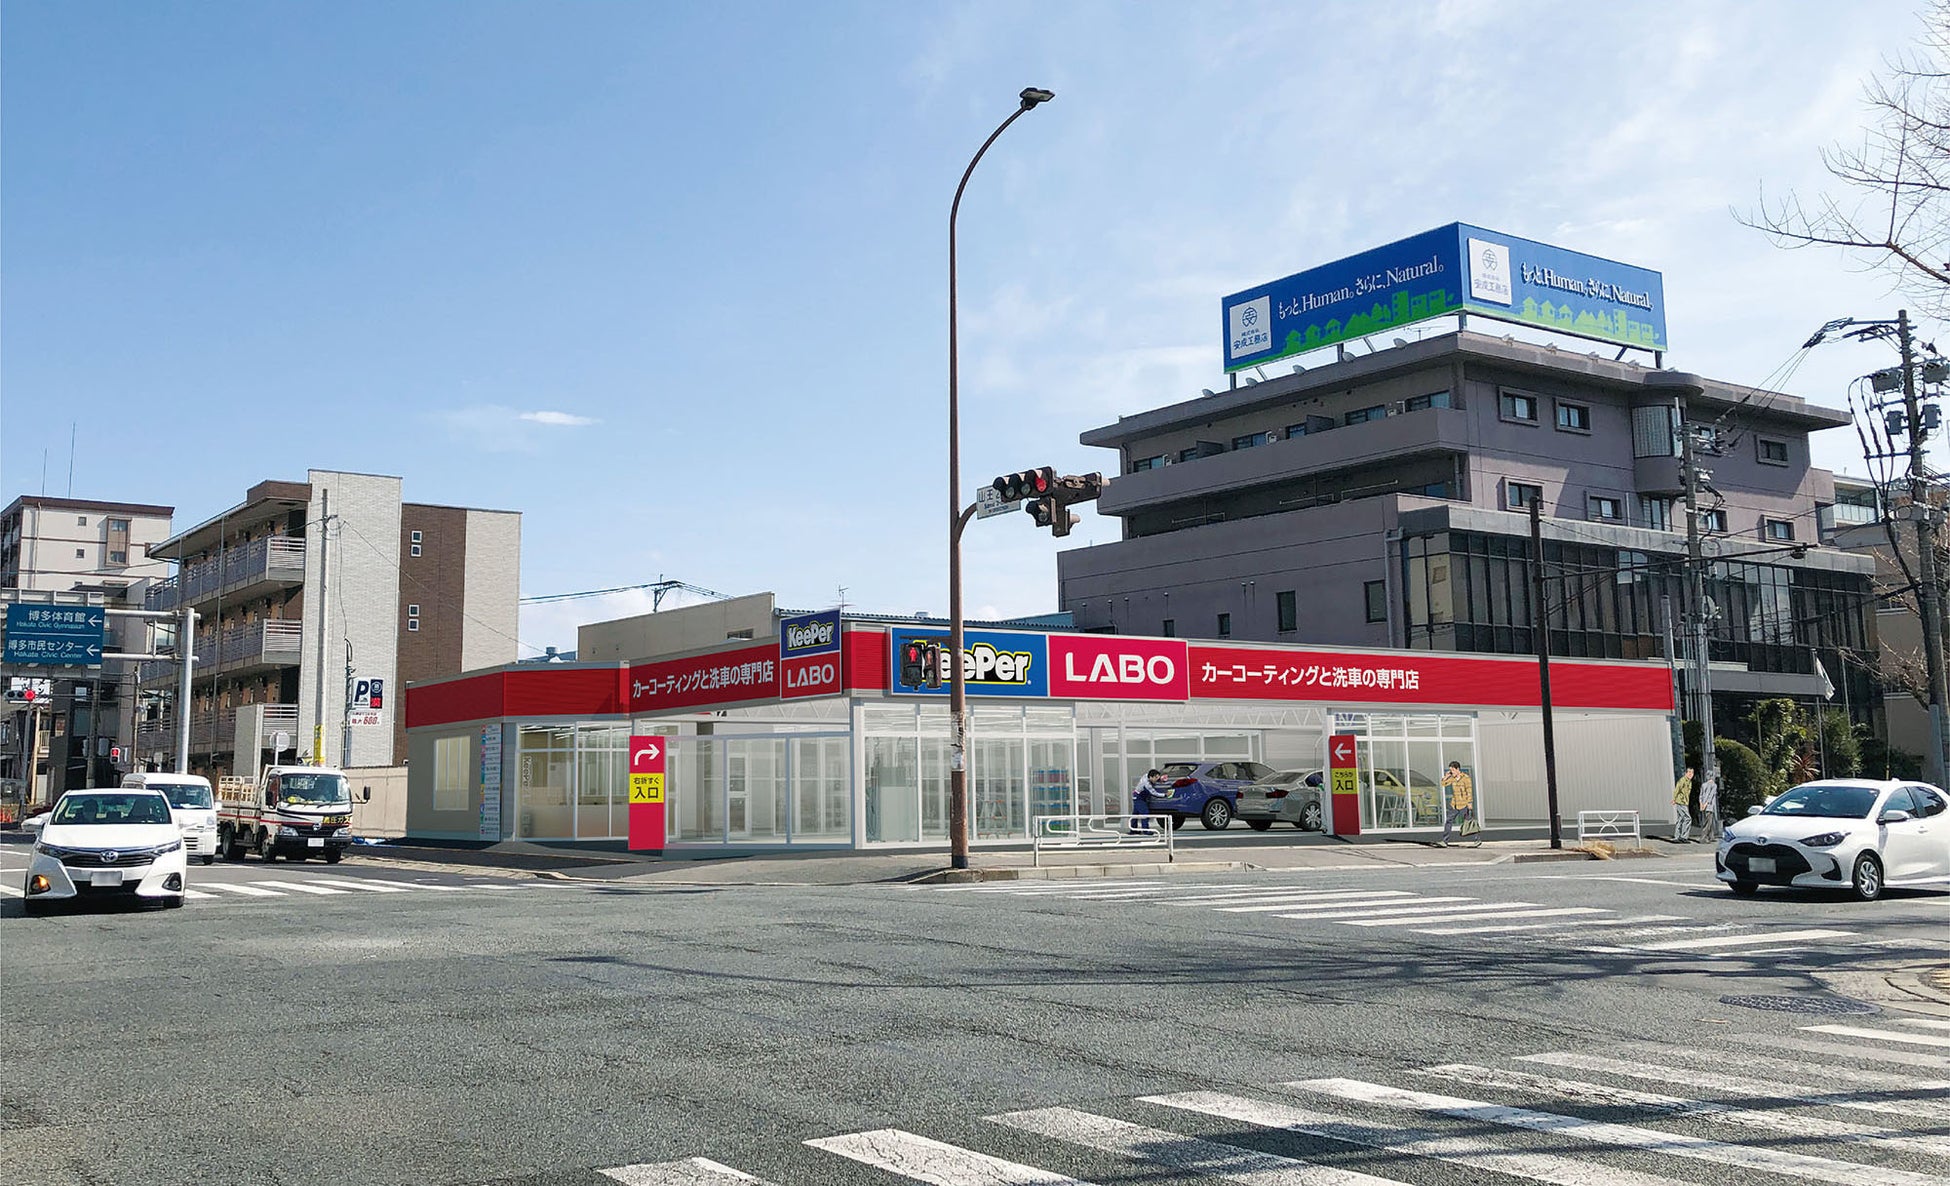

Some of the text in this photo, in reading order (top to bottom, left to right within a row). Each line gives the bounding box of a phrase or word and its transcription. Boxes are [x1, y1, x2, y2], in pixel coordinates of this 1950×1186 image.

[28, 609, 87, 623] 博多体育館
[8, 639, 84, 651] 博多市民センター
[787, 621, 834, 650] KeePer
[60, 651, 83, 659] Center
[916, 642, 1030, 682] eePer
[632, 659, 774, 699] カーコーティングと洗車の専門店
[786, 663, 835, 689] LABO
[1065, 652, 1175, 685] LABO
[1201, 661, 1420, 690] カーコーティングと洗車の専門店
[354, 680, 370, 703] P
[633, 777, 660, 785] 右折すぐ
[634, 786, 659, 799] 入口
[1335, 779, 1354, 791] 入口
